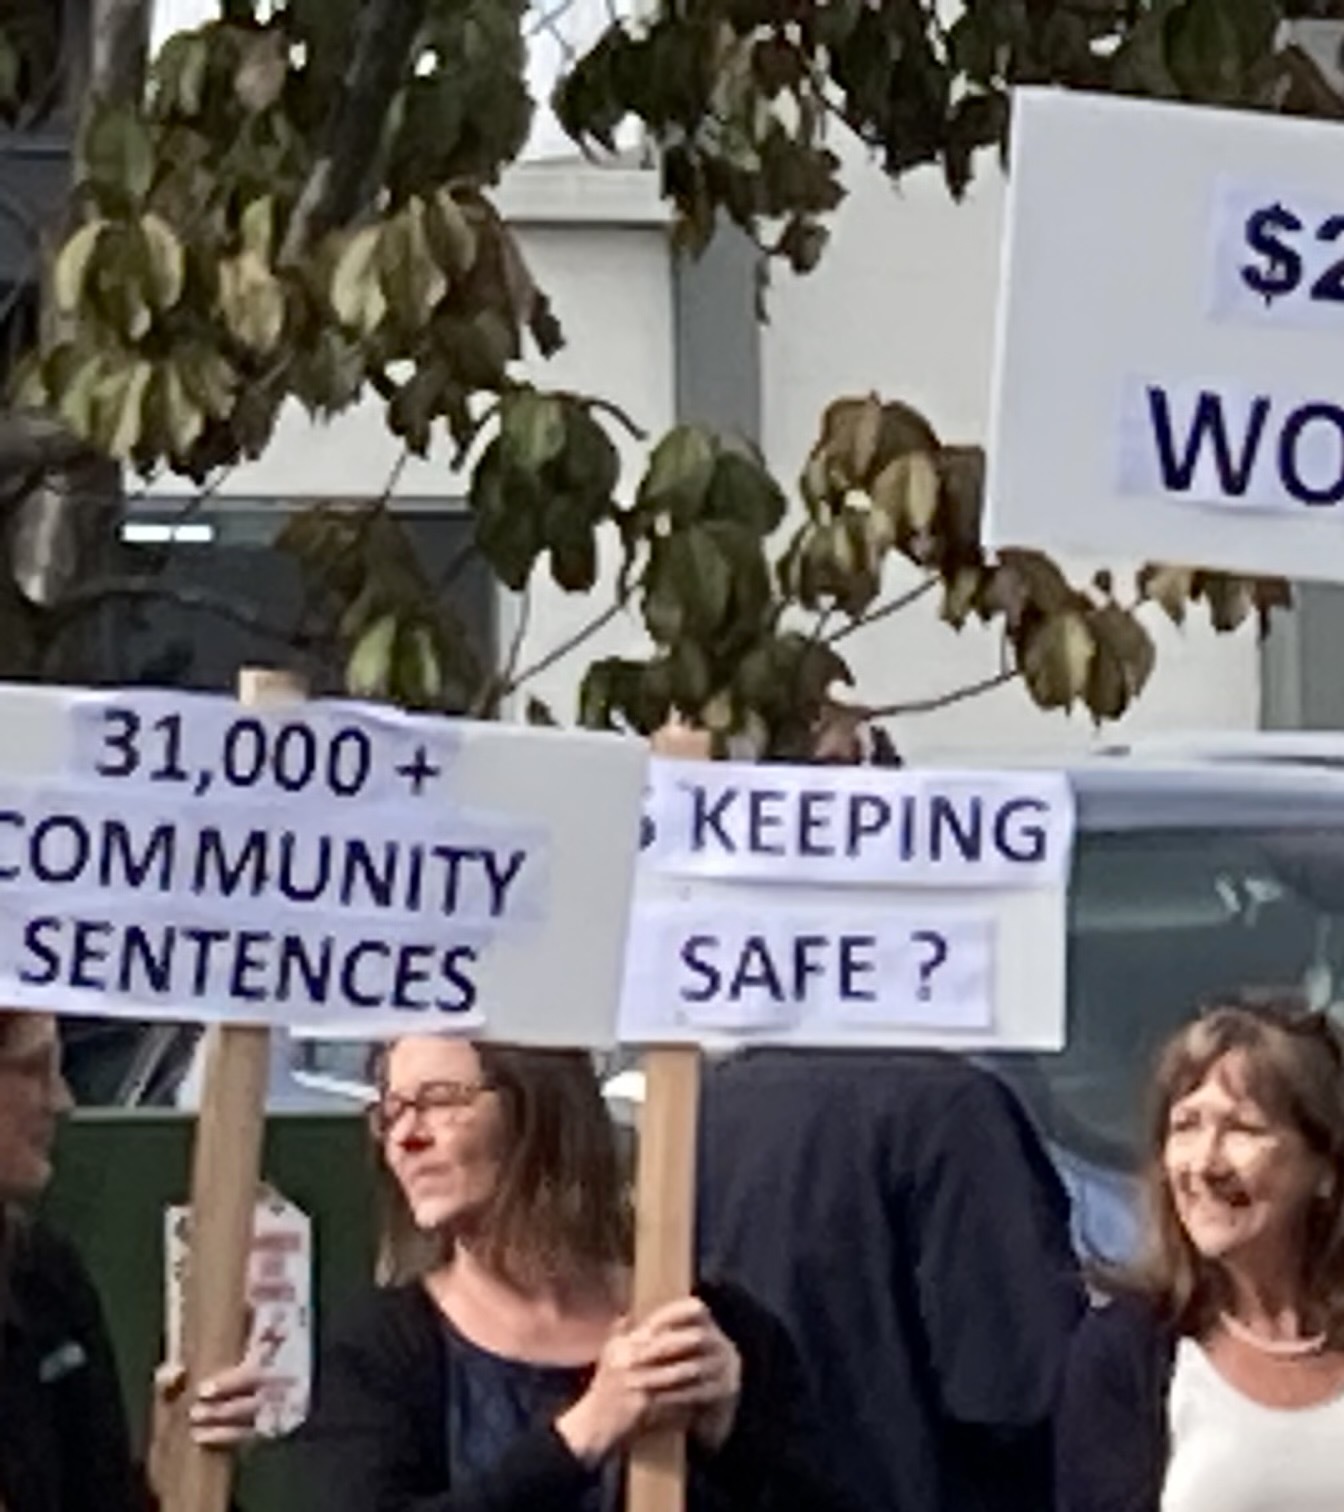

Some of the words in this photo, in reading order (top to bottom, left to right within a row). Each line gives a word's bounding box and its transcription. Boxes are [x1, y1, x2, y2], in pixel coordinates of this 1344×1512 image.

[95, 708, 373, 797] 31,000
[691, 787, 1050, 863] KEEPING
[19, 915, 479, 1013] SENTENCES
[680, 935, 878, 1002] SAFE
